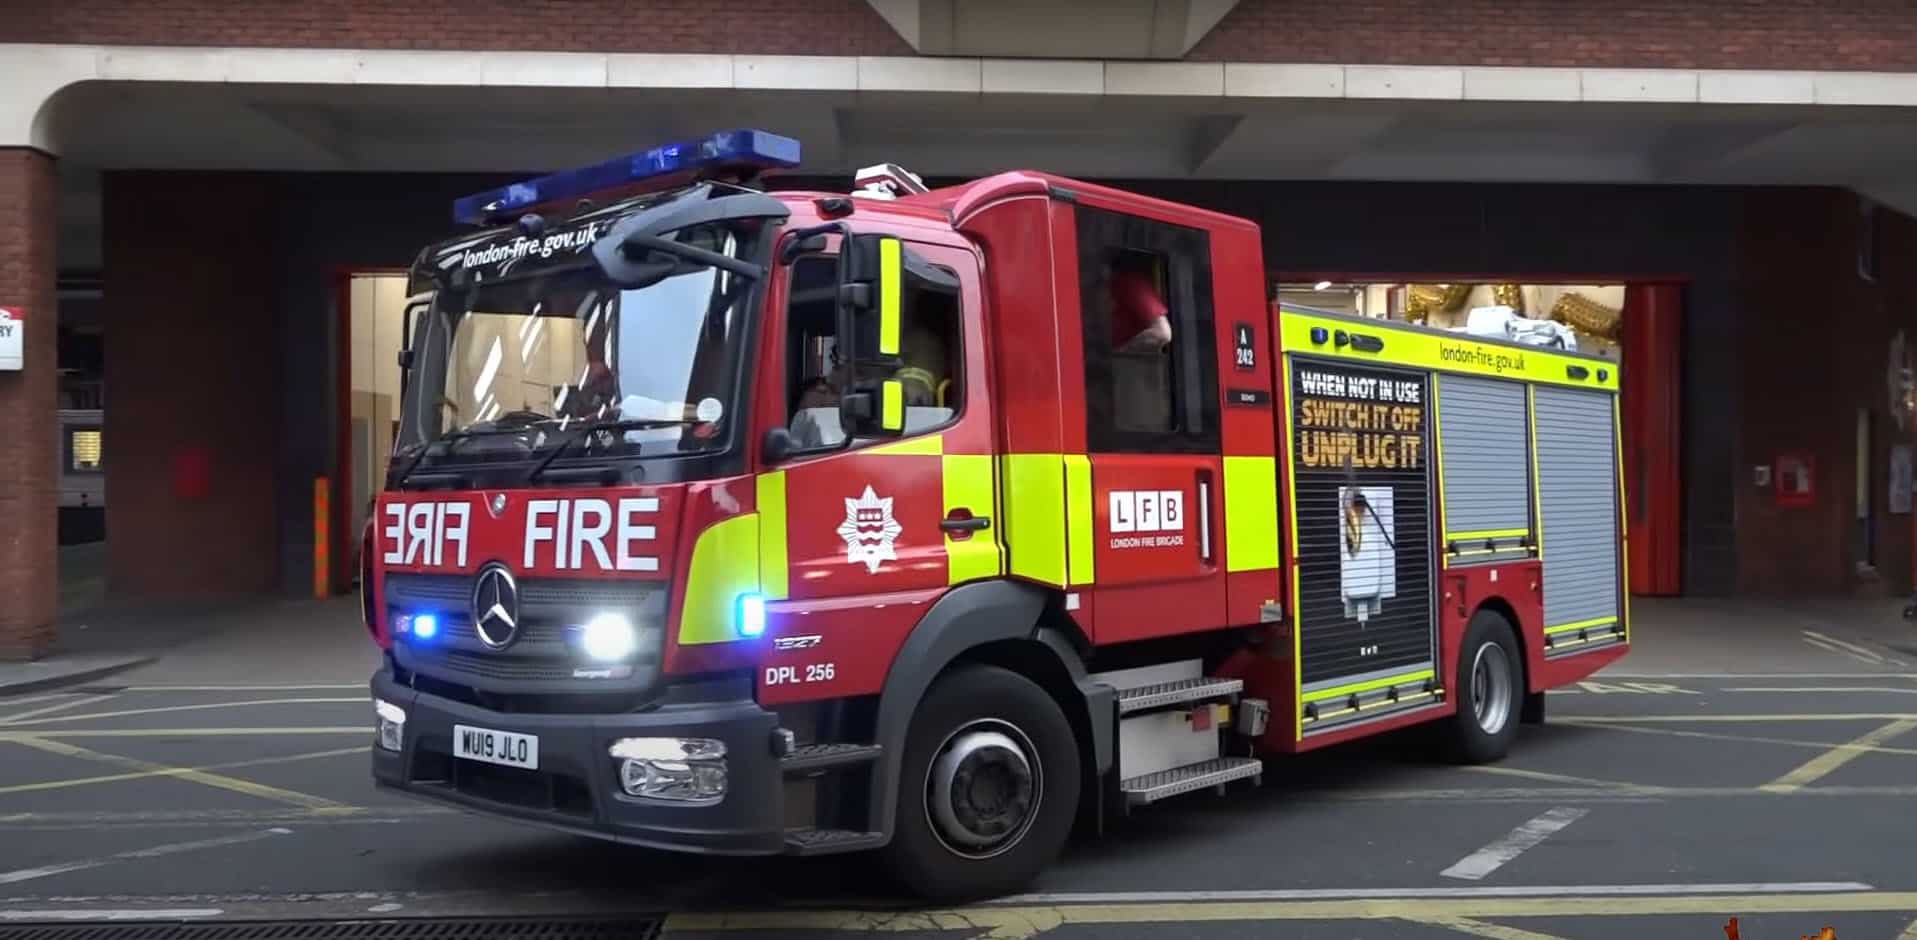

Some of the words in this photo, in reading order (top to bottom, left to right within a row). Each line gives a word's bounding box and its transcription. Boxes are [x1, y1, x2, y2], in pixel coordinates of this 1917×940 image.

[462, 222, 598, 269] london-fire.gov.uk
[1240, 328, 1247, 345] A
[1236, 348, 1254, 365] 242
[1440, 342, 1525, 373] london-fire.gov.uk
[1301, 371, 1346, 396] WHEN
[1348, 377, 1377, 399] NOT
[1379, 380, 1393, 401] IN
[1395, 381, 1420, 403] USE
[1302, 400, 1369, 428] SWITCH
[1373, 405, 1388, 430] IT
[1391, 406, 1420, 432] OFF
[1302, 431, 1396, 468] UNPLUG
[1400, 435, 1420, 468] IT
[523, 498, 659, 571] FIRE
[765, 666, 801, 685] DPL
[805, 663, 835, 682] 256
[462, 730, 494, 758] WU19
